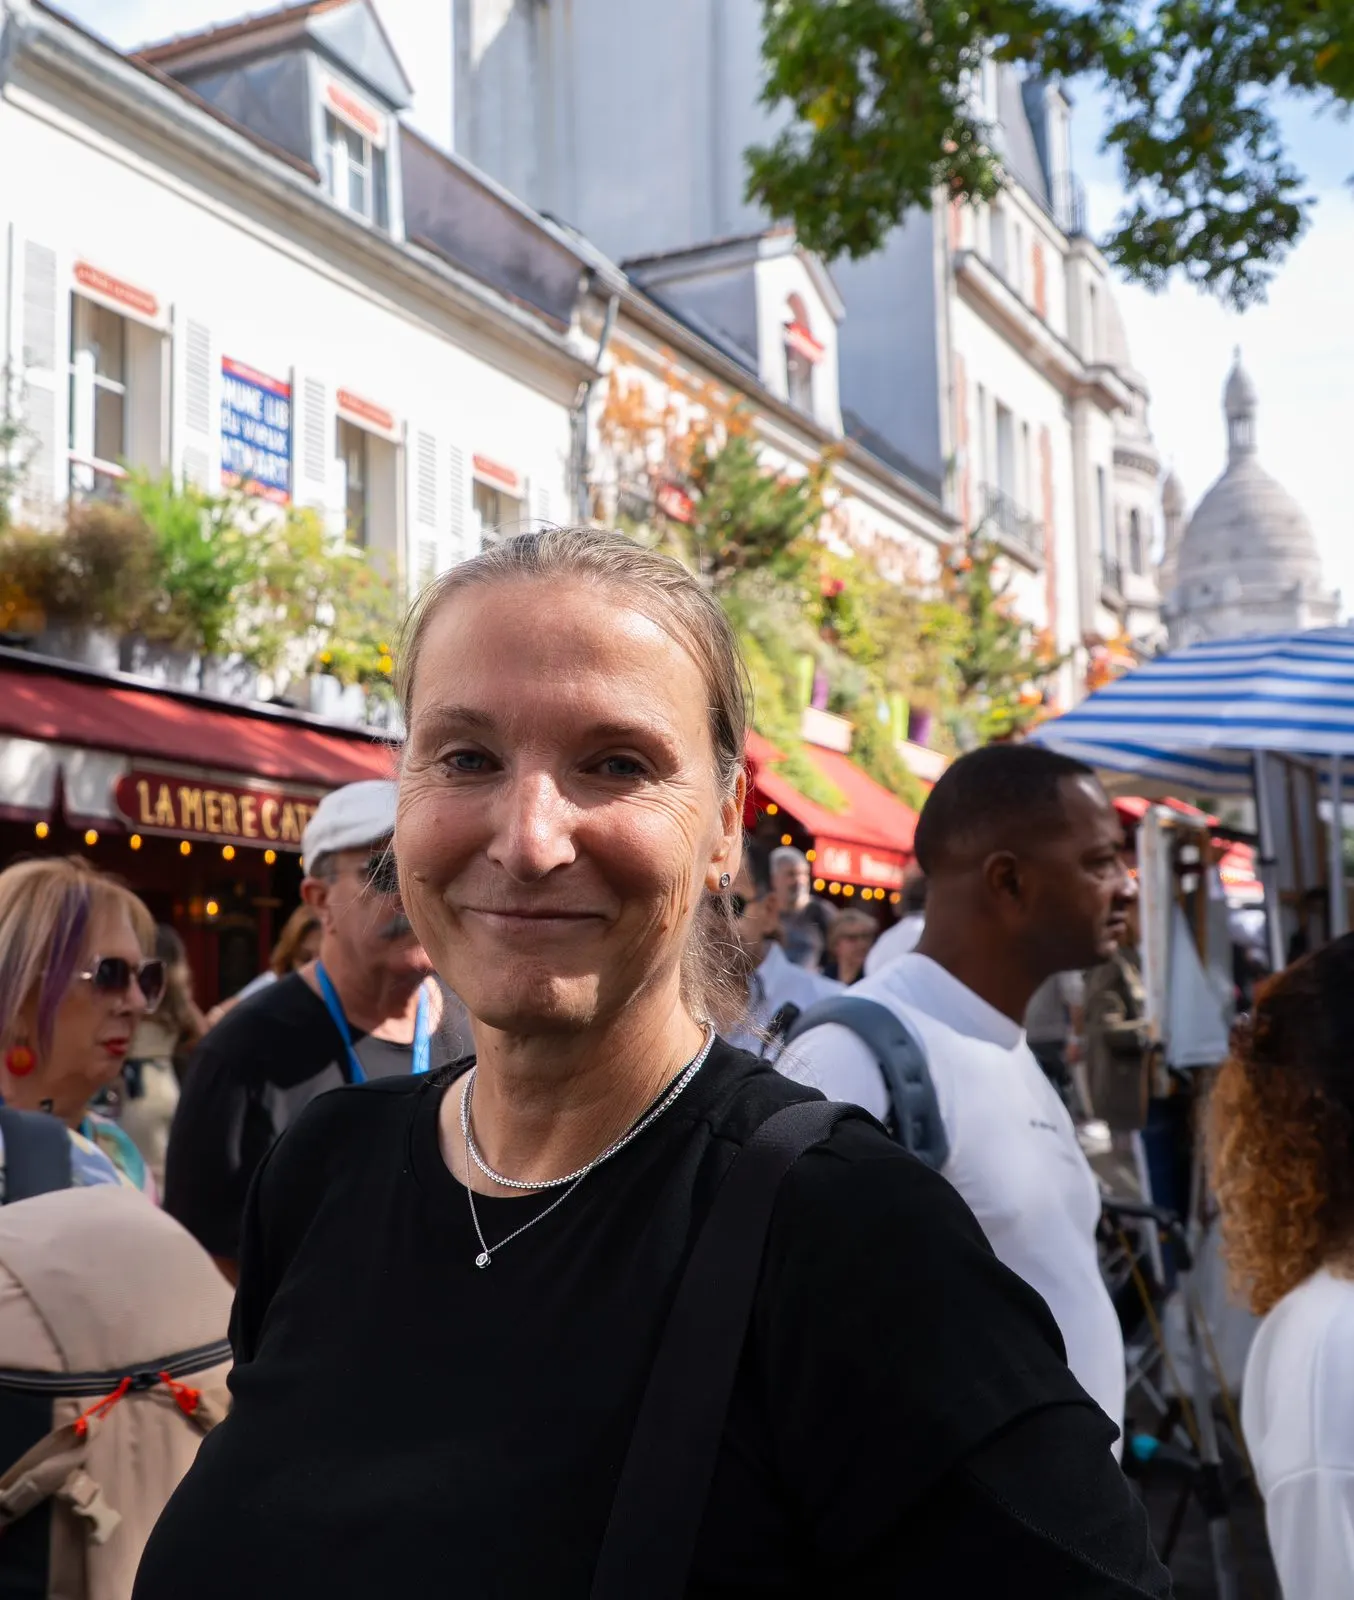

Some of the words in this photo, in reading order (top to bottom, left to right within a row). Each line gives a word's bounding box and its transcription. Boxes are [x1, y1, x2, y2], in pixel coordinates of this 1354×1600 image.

[137, 779, 176, 827] LA
[178, 786, 258, 837] MERE
[261, 798, 318, 842] CAT
